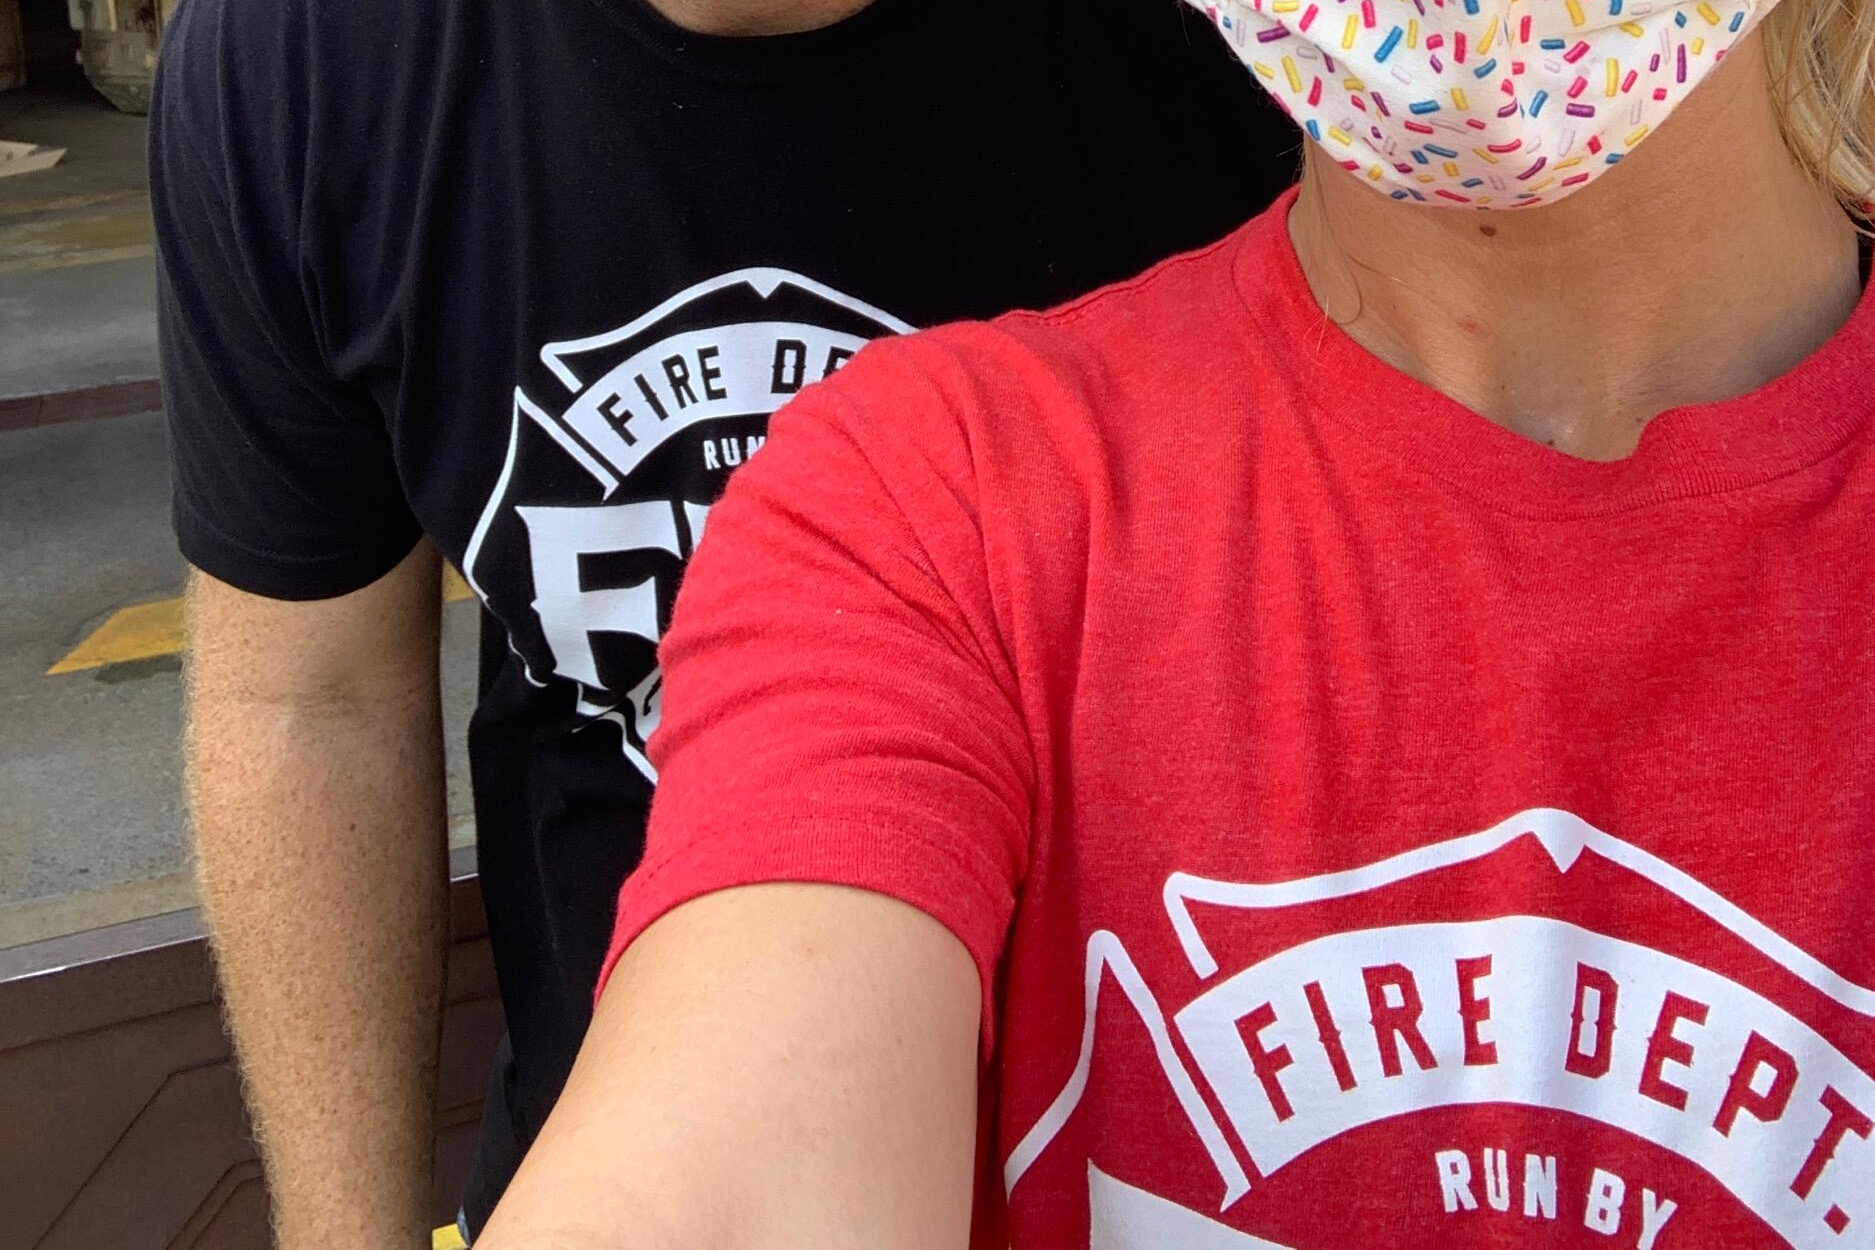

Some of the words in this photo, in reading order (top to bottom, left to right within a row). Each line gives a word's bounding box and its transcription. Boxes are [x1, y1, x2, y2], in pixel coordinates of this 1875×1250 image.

[596, 345, 727, 447] FIRE
[1234, 954, 1498, 1123] FIRE
[1564, 961, 1874, 1236] DEPT.
[1435, 1147, 1558, 1220] RUN
[1584, 1167, 1679, 1250] BY
